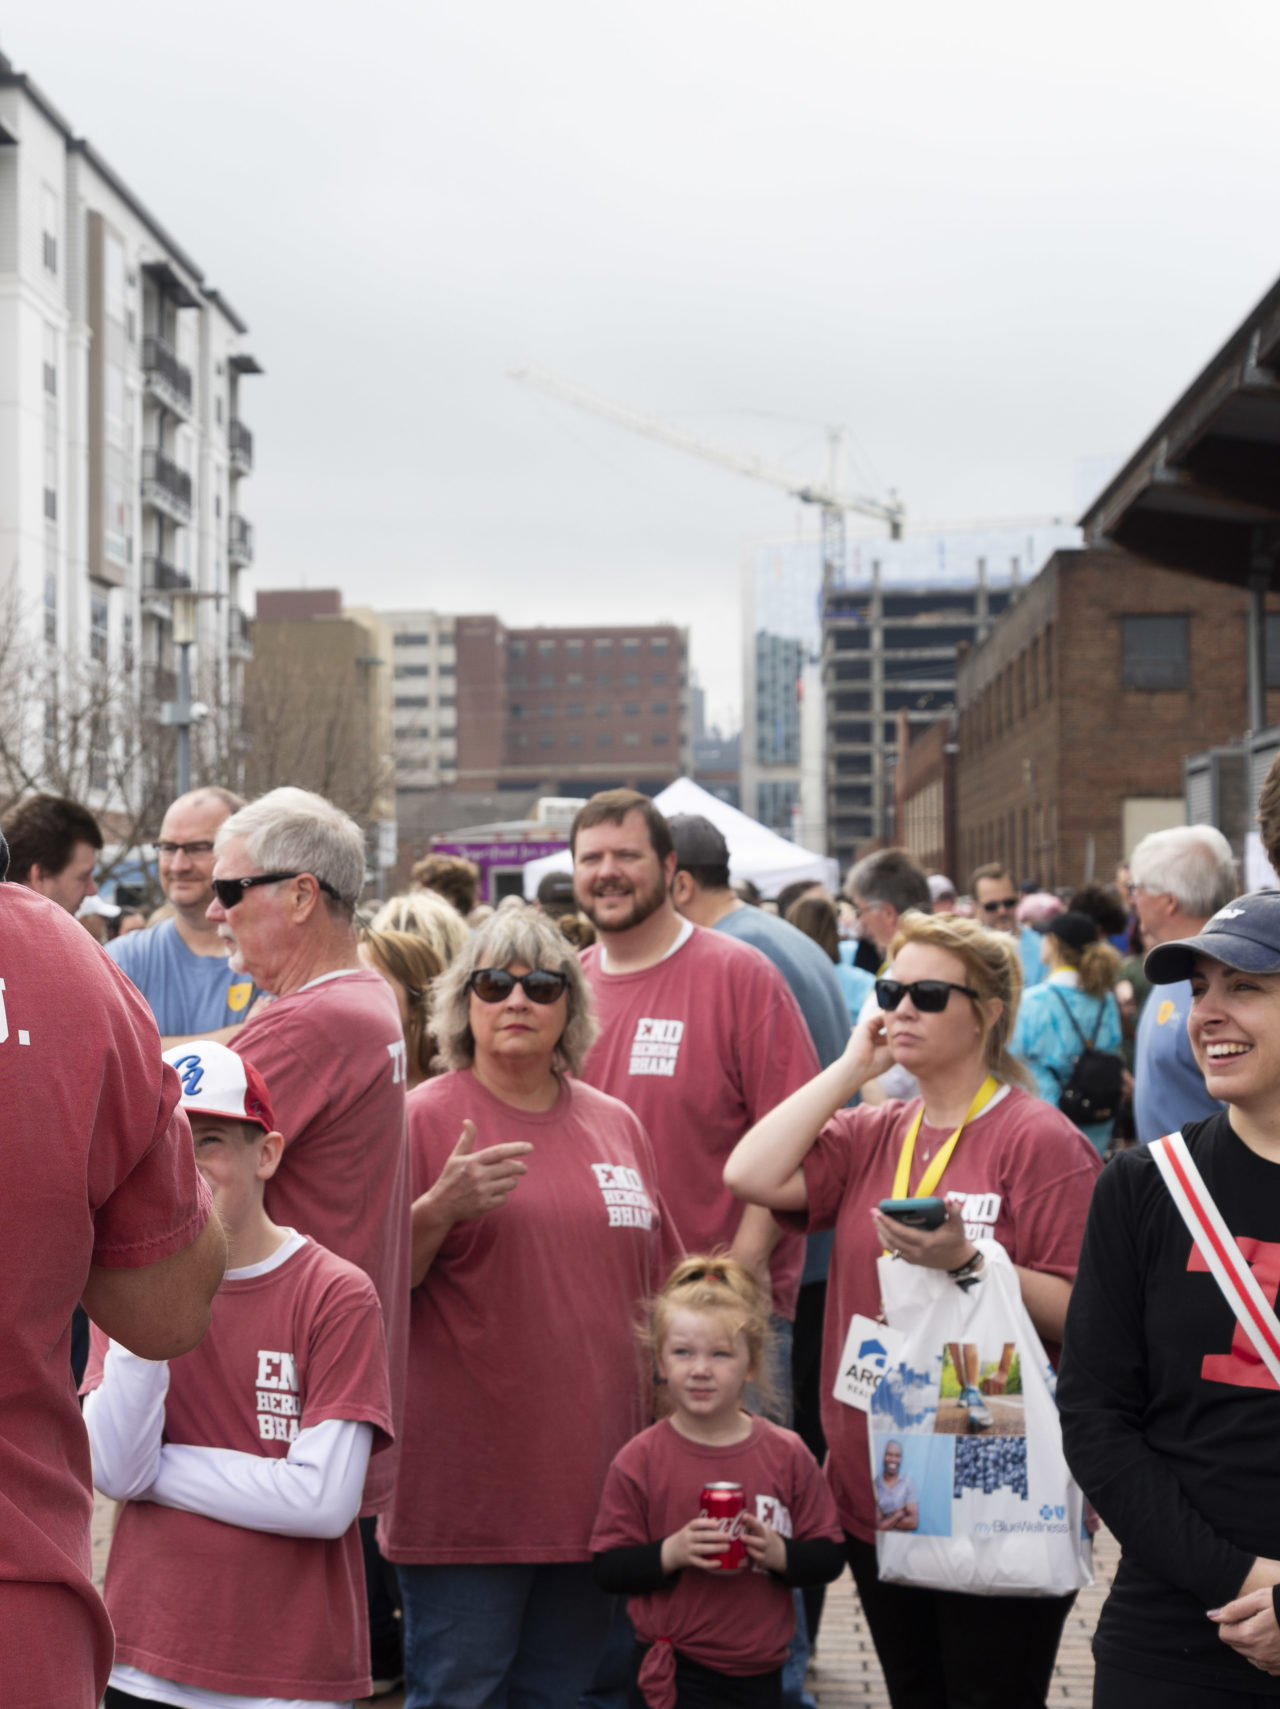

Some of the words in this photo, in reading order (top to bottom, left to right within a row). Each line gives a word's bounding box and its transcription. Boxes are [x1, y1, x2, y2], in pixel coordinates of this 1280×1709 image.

[634, 1018, 684, 1044] END
[591, 1163, 643, 1192] END
[256, 1350, 299, 1392] EN
